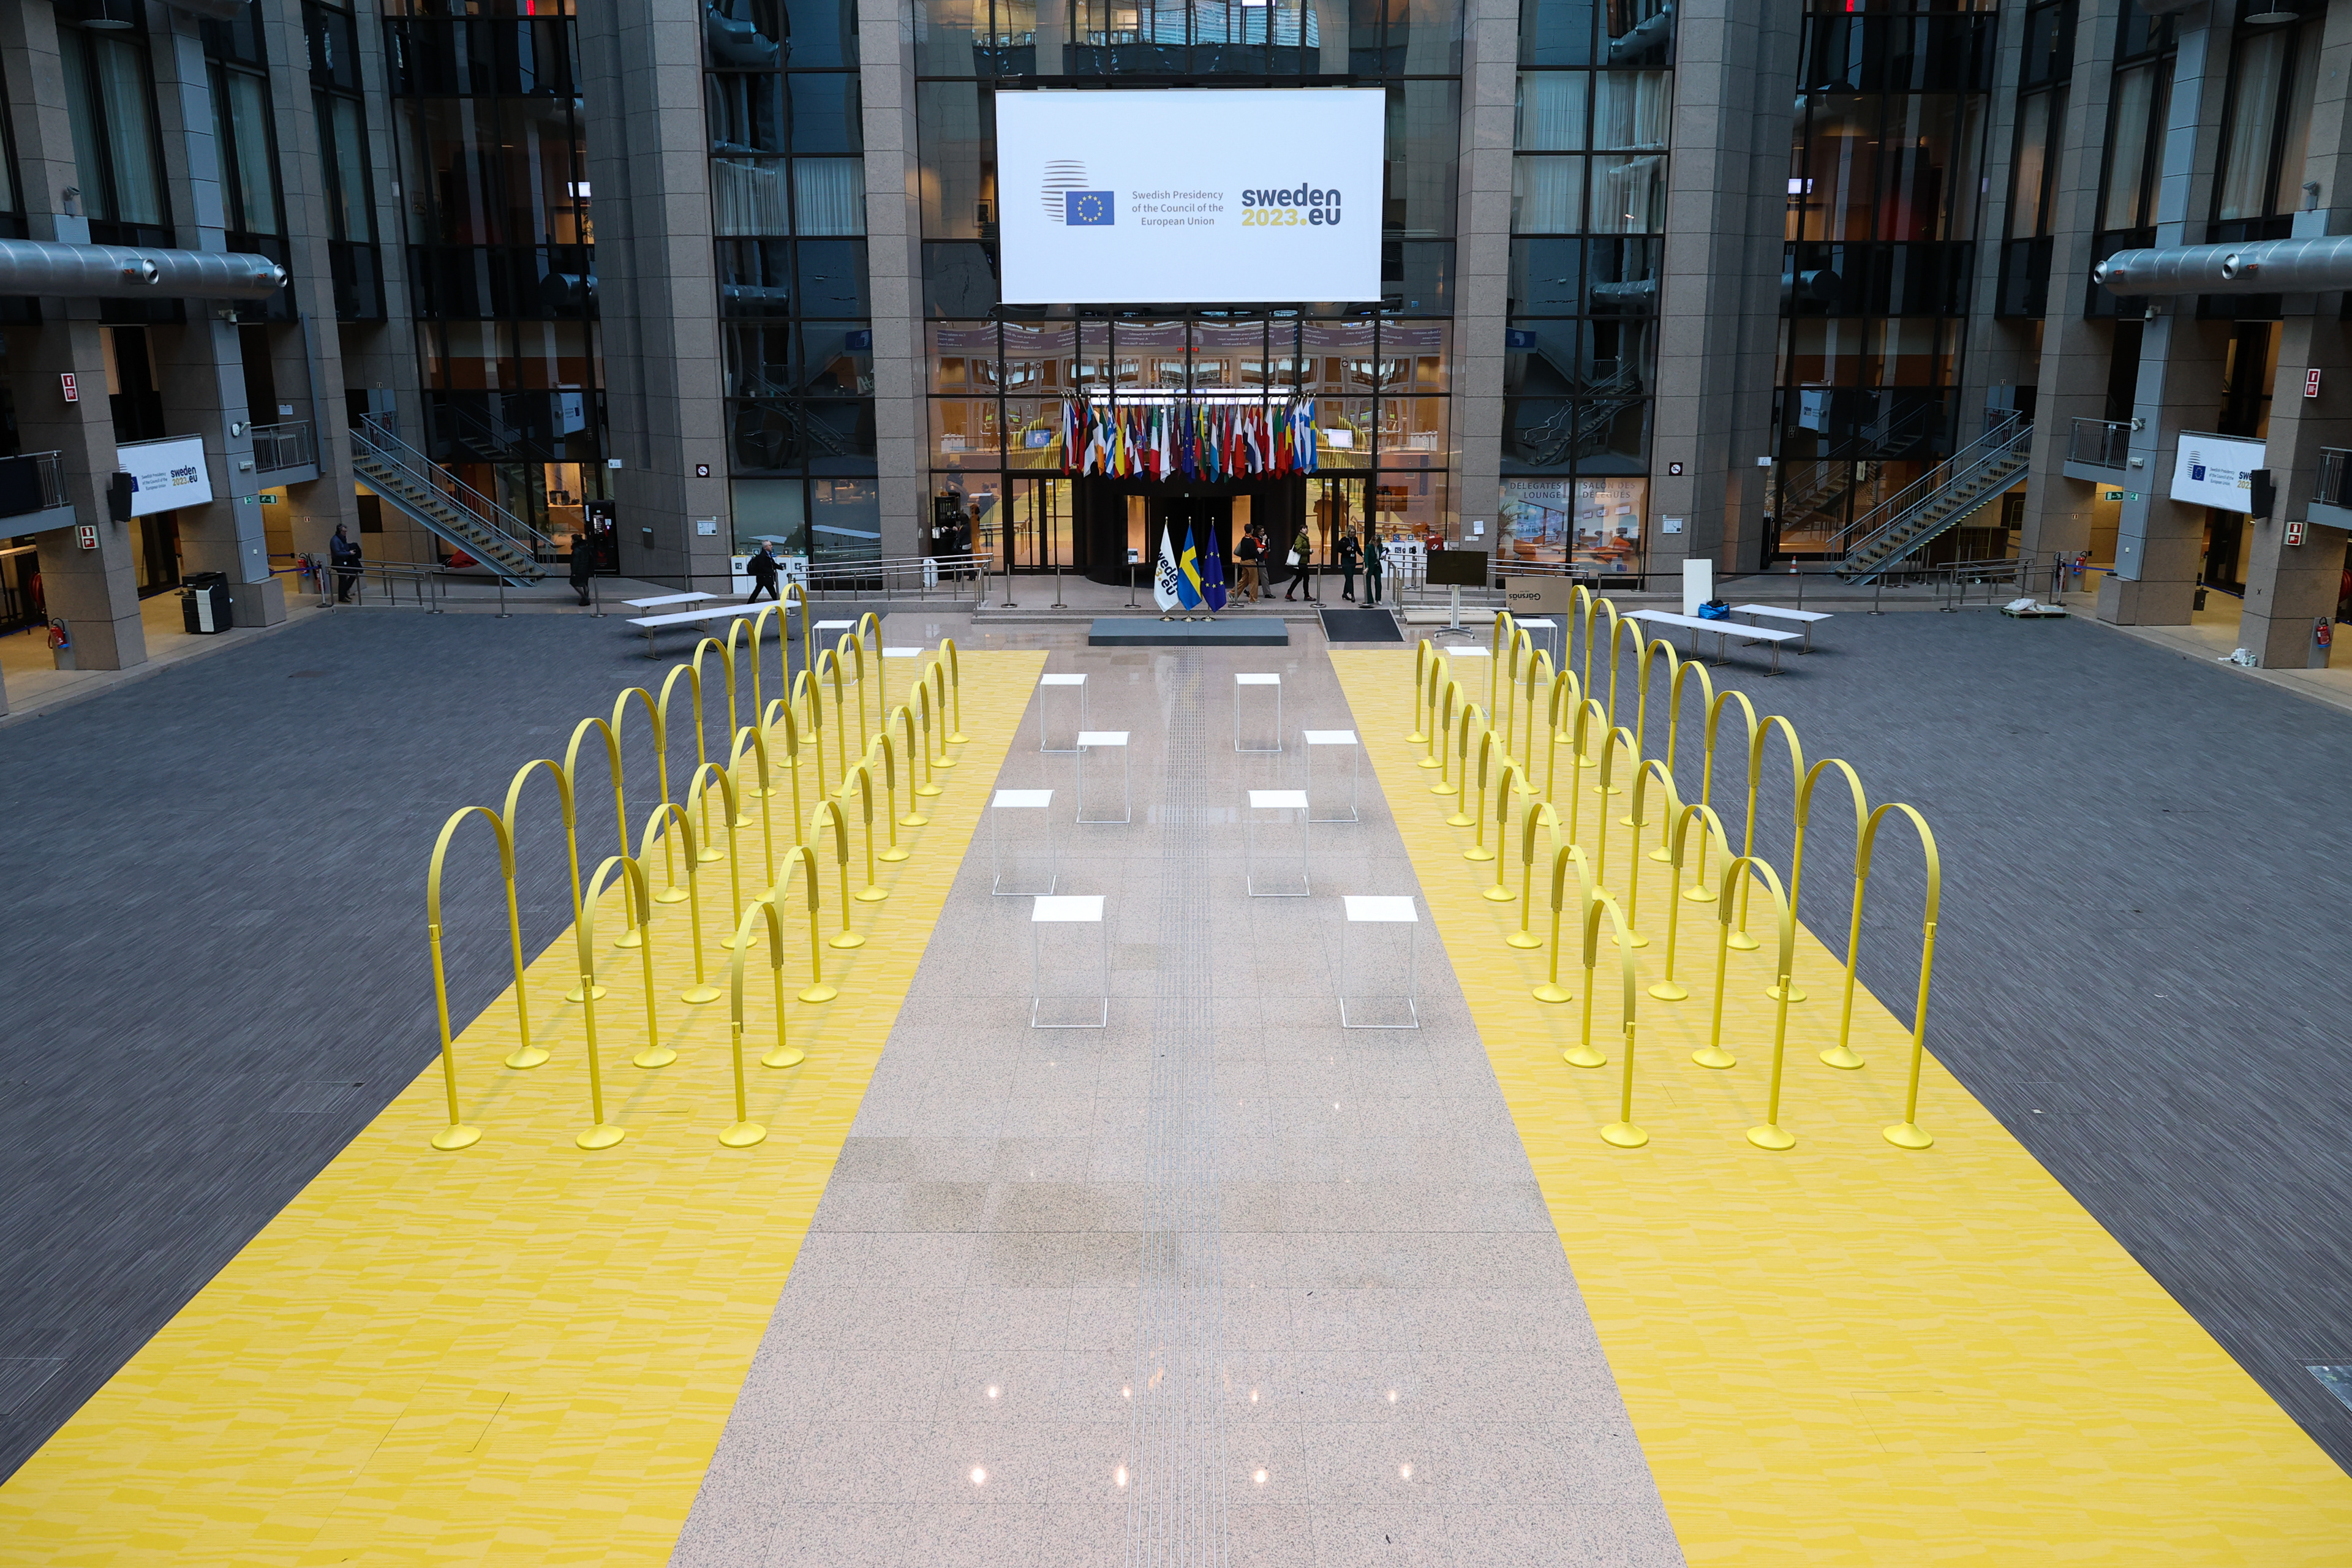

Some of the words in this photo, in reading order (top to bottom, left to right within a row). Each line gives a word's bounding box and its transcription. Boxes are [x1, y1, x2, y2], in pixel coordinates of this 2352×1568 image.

[1133, 190, 1170, 199] Swedish
[1173, 190, 1223, 201] Presidency
[1242, 183, 1341, 207] sweden
[1132, 204, 1141, 213] of
[1144, 204, 1158, 213] the
[1161, 203, 1195, 213] Council
[1197, 203, 1207, 212] of
[1208, 203, 1224, 212] the
[1141, 217, 1185, 227] European
[1242, 208, 1341, 226] 2023.eu
[171, 465, 196, 477] sweden
